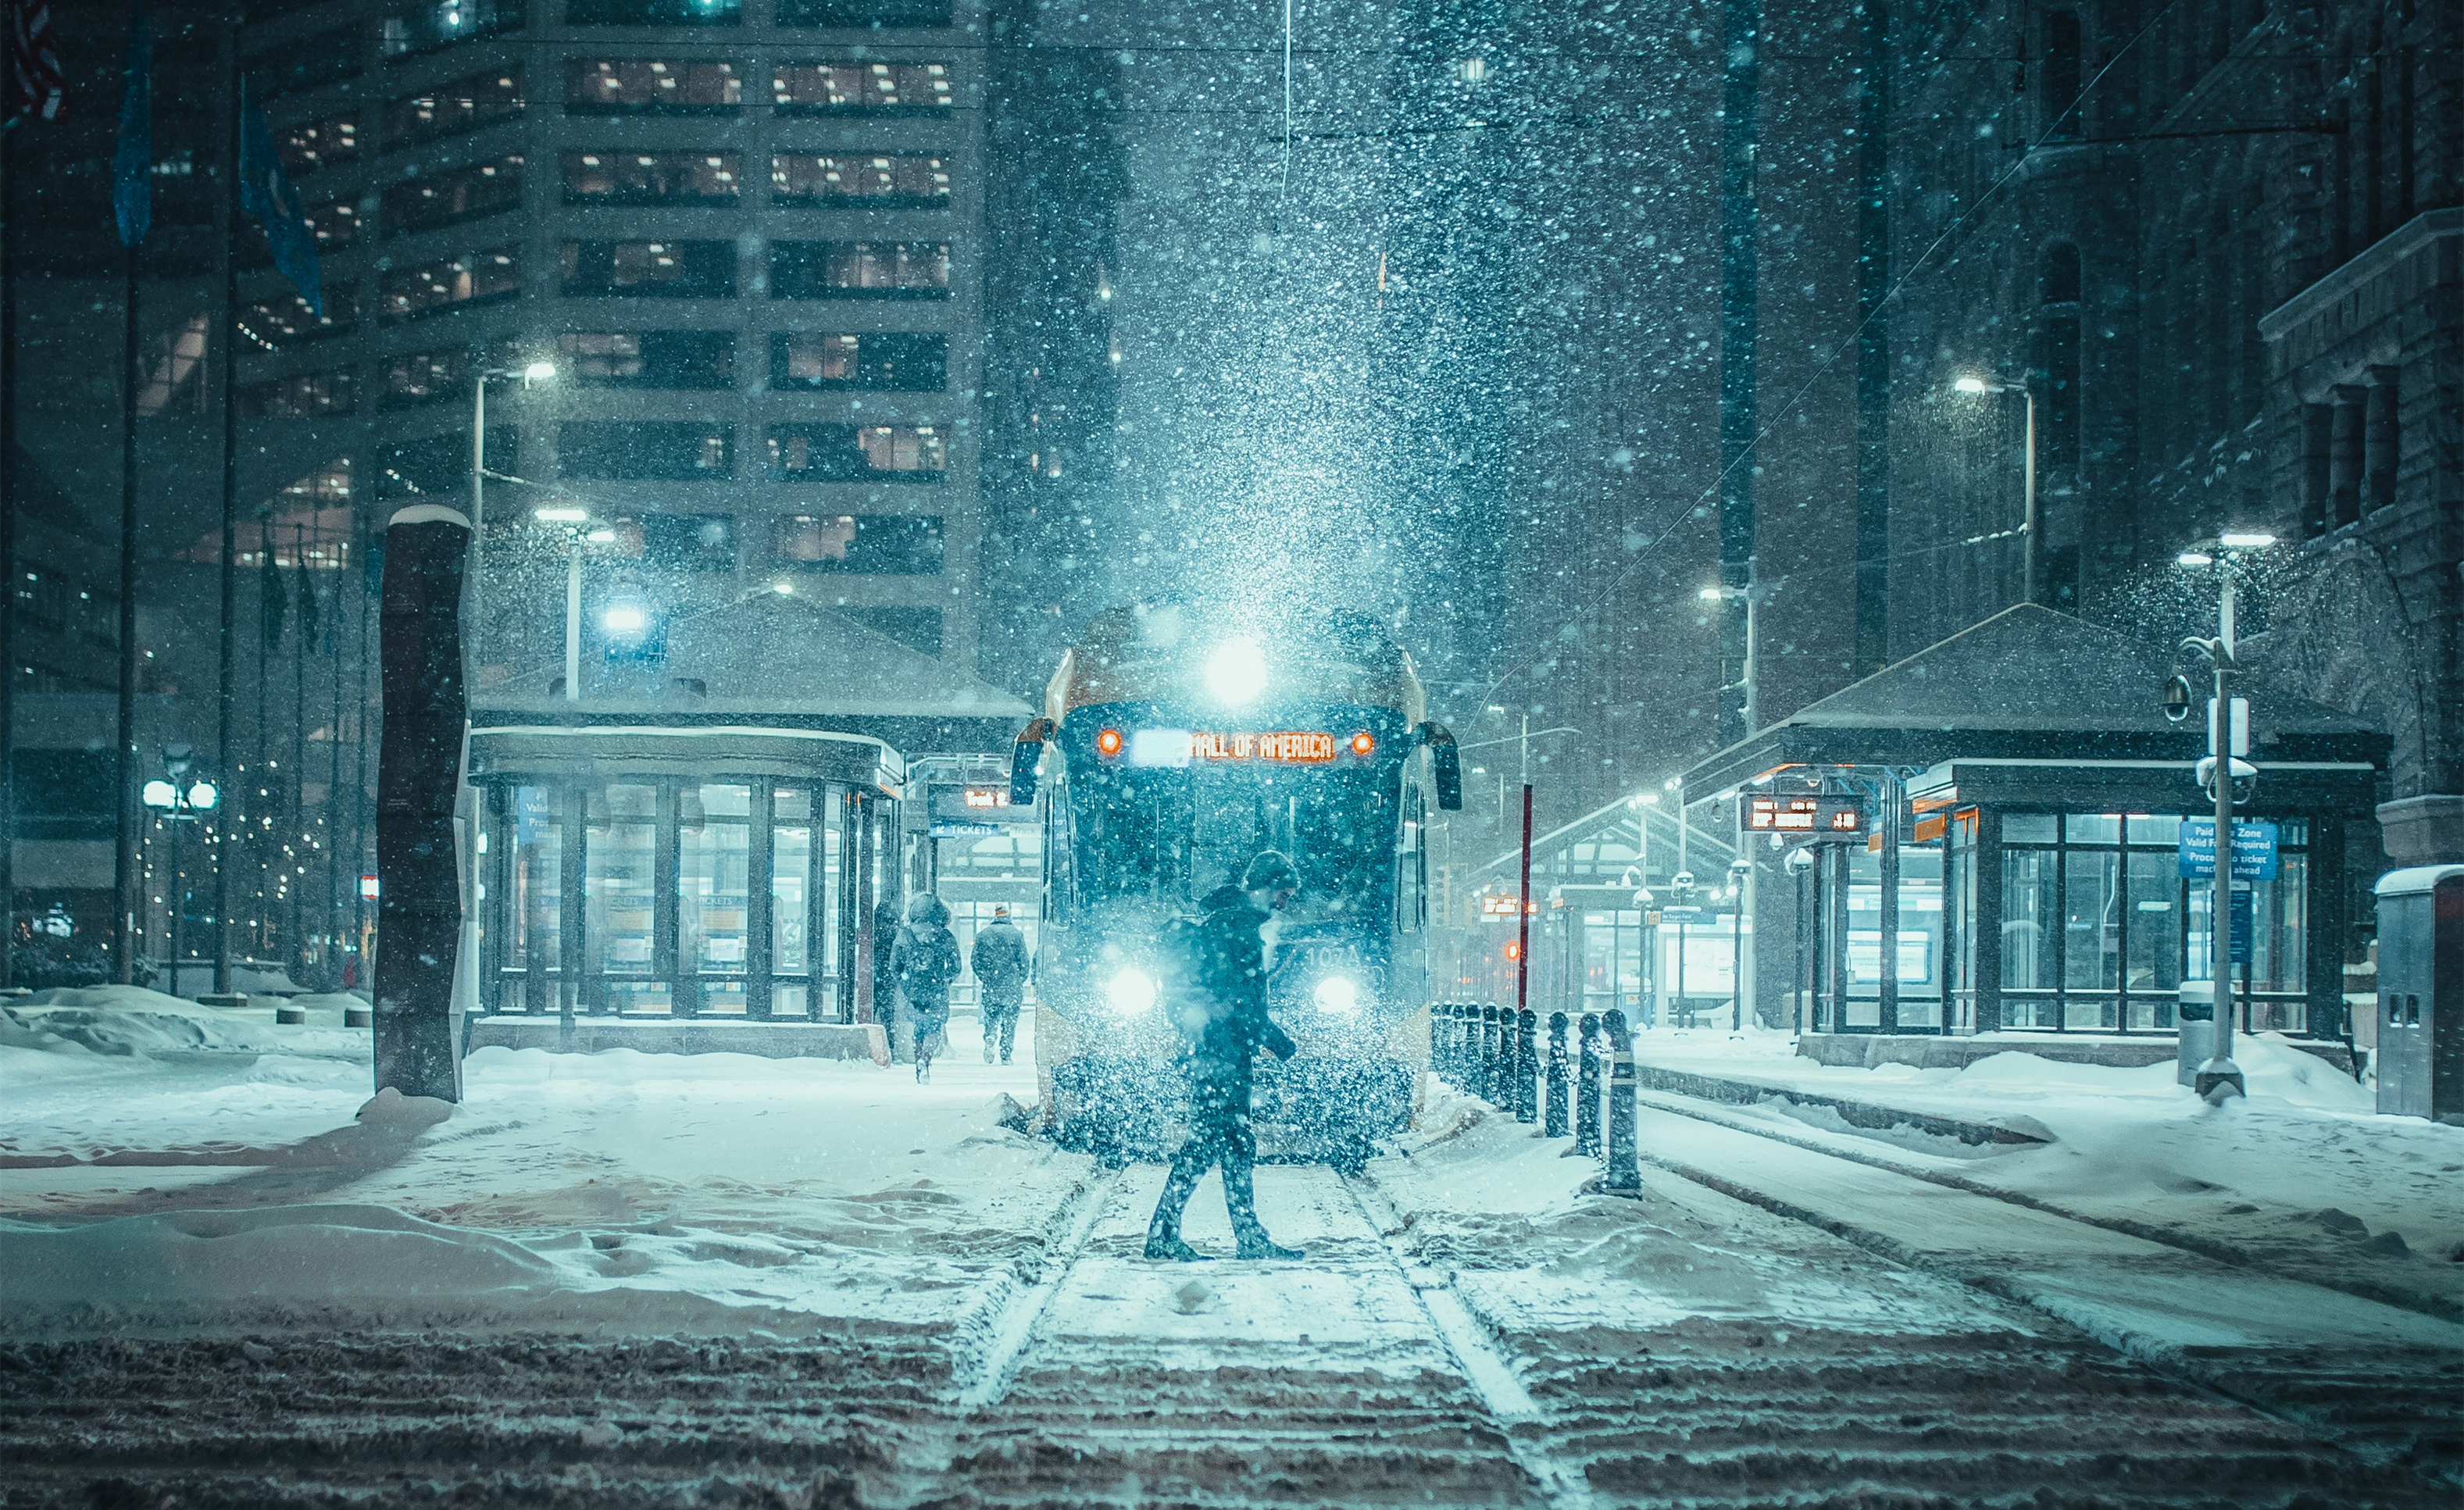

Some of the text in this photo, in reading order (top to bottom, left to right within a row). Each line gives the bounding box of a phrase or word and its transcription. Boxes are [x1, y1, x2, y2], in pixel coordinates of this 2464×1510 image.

[1234, 734, 1255, 757] OF
[1259, 734, 1331, 758] AMERICA
[951, 825, 992, 835] TICKETS
[2195, 826, 2214, 837] Paid
[2237, 828, 2262, 838] Zone
[2185, 837, 2207, 848] Valid
[2230, 839, 2271, 851] Required
[2241, 855, 2267, 864] ticket
[2234, 866, 2261, 875] ahead
[1305, 944, 1361, 967] 107A
